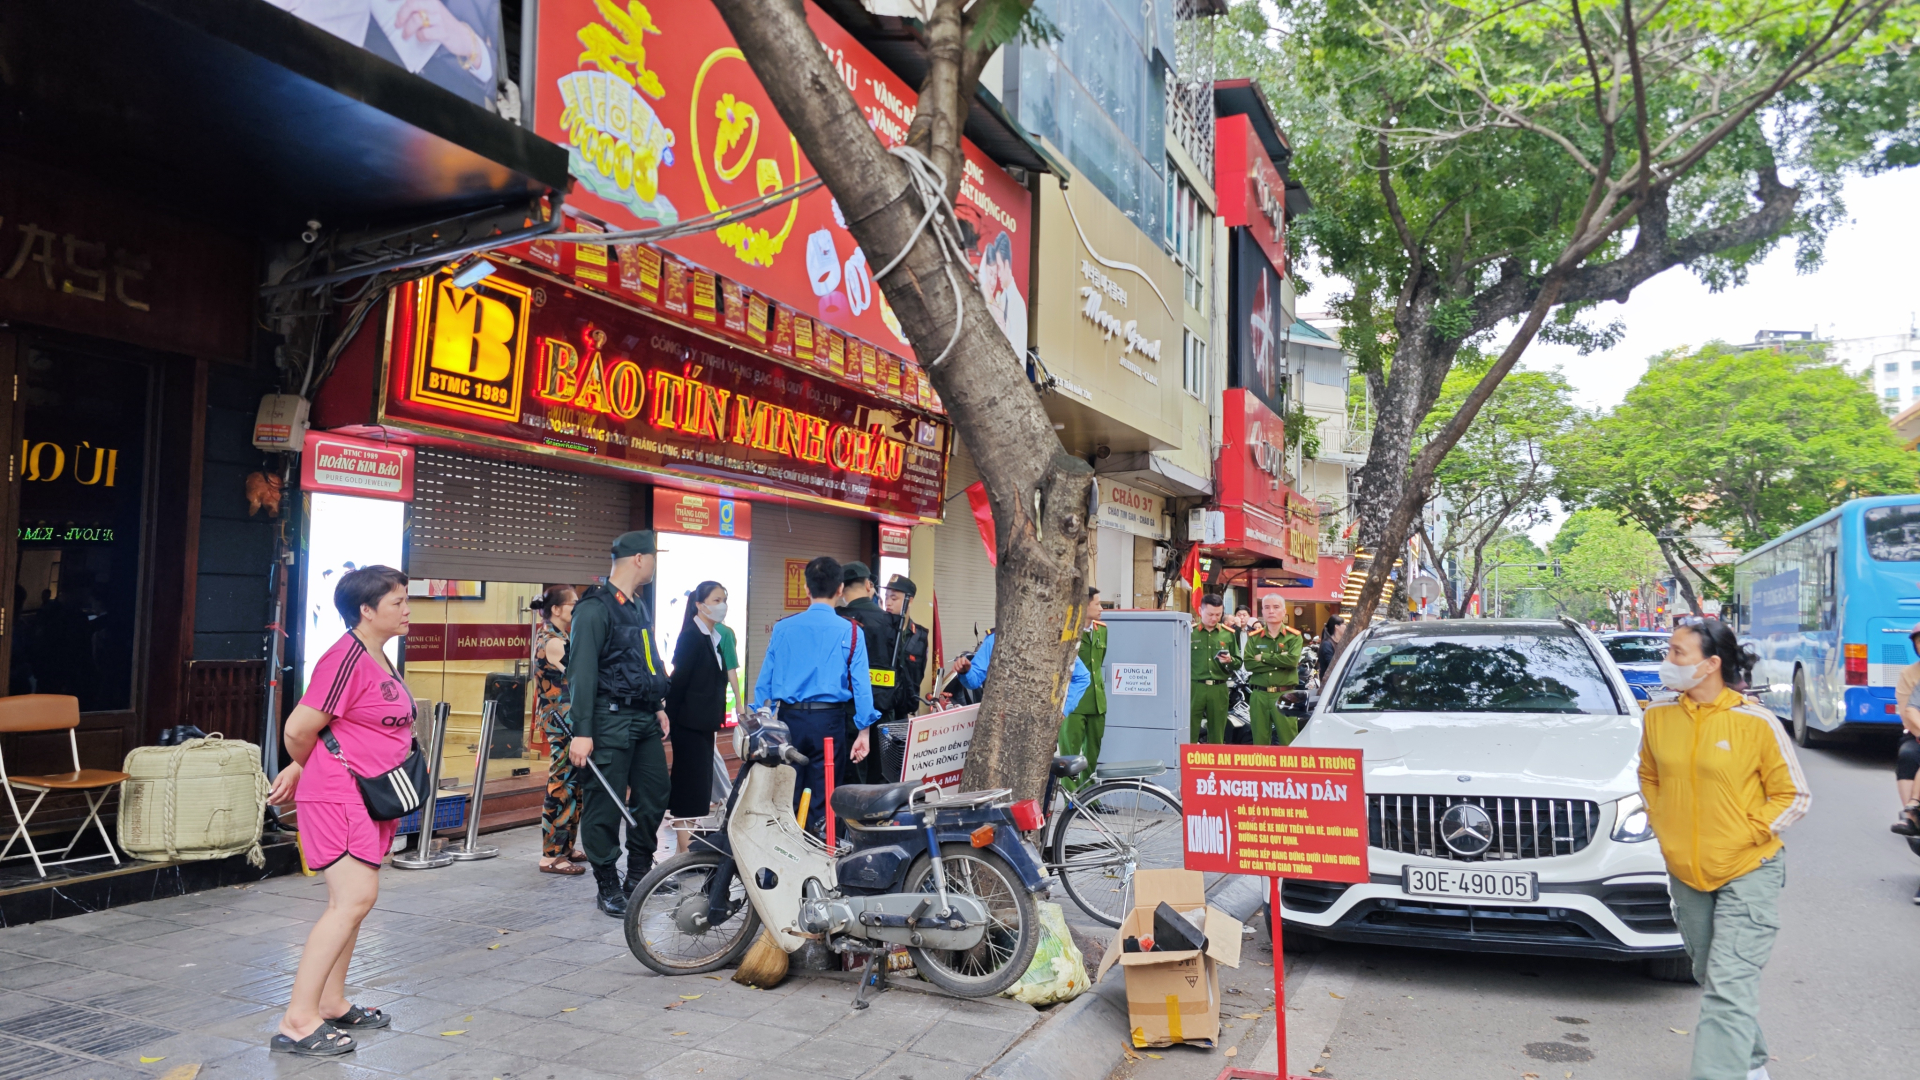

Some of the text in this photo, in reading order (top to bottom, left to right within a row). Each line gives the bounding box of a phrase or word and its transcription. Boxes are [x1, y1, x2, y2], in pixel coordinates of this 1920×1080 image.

[873, 79, 904, 120] VÀNG
[1000, 210, 1017, 233] CAO
[700, 351, 726, 370] TNHH
[429, 372, 508, 405] BTMC 1989
[540, 329, 646, 419] BẢO
[656, 364, 730, 440] TÍN
[733, 394, 829, 463] MINH
[832, 423, 906, 481] CHÂU
[581, 424, 606, 442] VÀNG
[631, 434, 658, 453] THĂNG
[343, 448, 378, 460] BTMC 1989
[319, 453, 399, 477] HOÀNG KIM BẢO
[325, 473, 392, 488] PURE GOLD JEWELRY
[1112, 487, 1153, 513] CHÁO 37
[676, 507, 694, 518] THĂNG
[695, 510, 709, 520] LONG
[1120, 510, 1128, 519] TIM
[407, 635, 442, 643] MINH CHÂU
[457, 635, 527, 648] HÂN HOAN ĐÓN
[931, 721, 966, 737] BẢO TÍN
[913, 747, 938, 759] HƯỚNG
[947, 740, 962, 751] ĐẾN
[911, 758, 935, 771] VÀNG
[936, 752, 959, 766] RỒNG
[1186, 751, 1356, 770] CÔNG AN PHƯỜNG HAI BÀ TRƯNG
[944, 774, 960, 785] MAI
[1196, 772, 1348, 802] ĐỀ NGHỊ NHÂN DÂN
[863, 810, 890, 818] CUP
[1256, 806, 1261, 816] Ô
[1262, 806, 1270, 817] TÔ
[1270, 807, 1286, 817] TRÊN
[1187, 809, 1225, 855] KHÔNG
[1238, 821, 1258, 832] KHÔNG
[1267, 822, 1275, 832] XE
[1275, 823, 1288, 833] MÁY
[1289, 824, 1304, 834] TRÊN
[1342, 826, 1358, 837] LÒNG
[1259, 834, 1269, 843] SAI
[1270, 835, 1282, 845] QUY
[1239, 847, 1259, 859] KHÔNG
[1260, 848, 1271, 859] XẾP
[1271, 849, 1288, 860] HÀNG
[1322, 853, 1337, 864] LÒNG
[1239, 858, 1313, 874] GÂY CẢN TRỞ GIAO THÔNG
[1412, 869, 1527, 897] 30E-490.05
